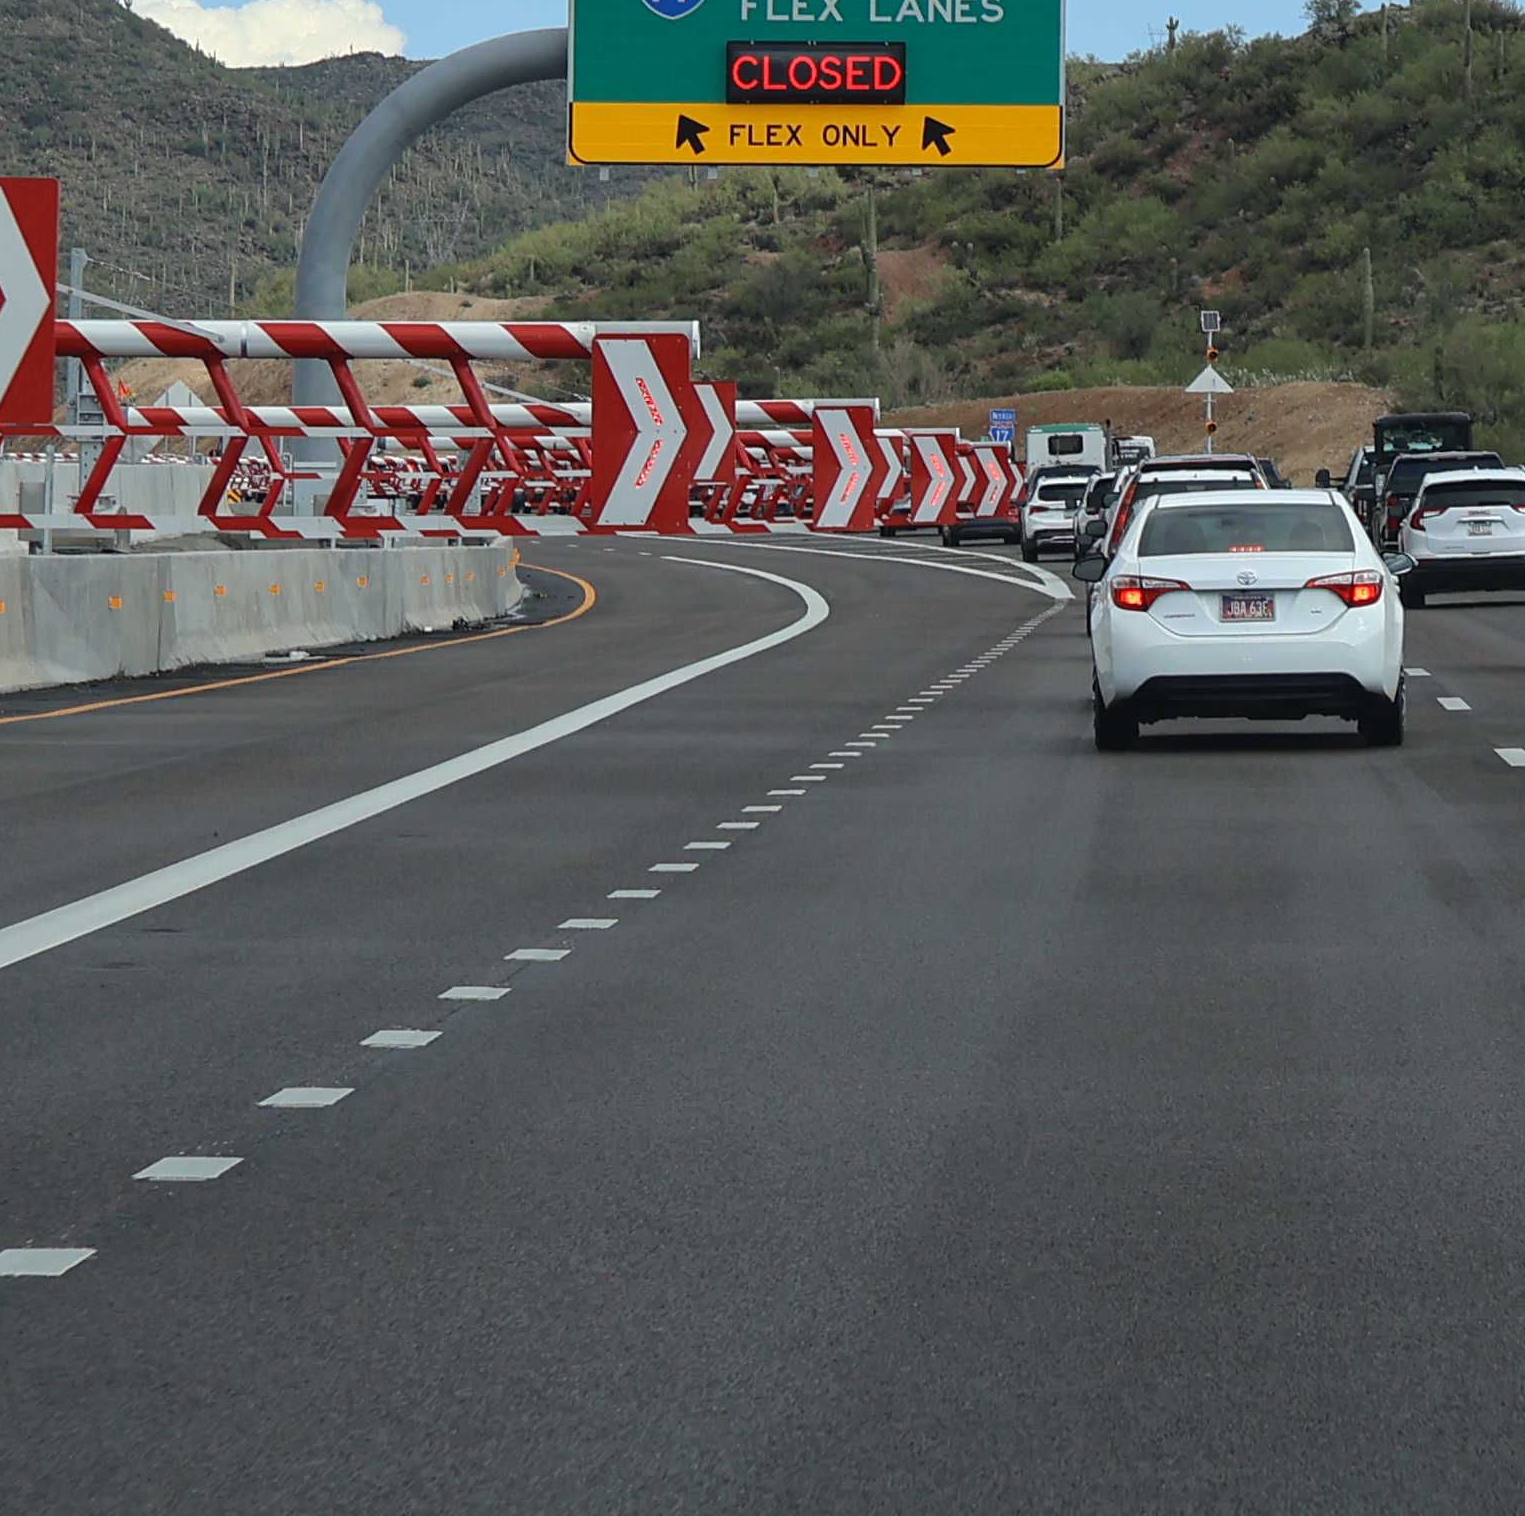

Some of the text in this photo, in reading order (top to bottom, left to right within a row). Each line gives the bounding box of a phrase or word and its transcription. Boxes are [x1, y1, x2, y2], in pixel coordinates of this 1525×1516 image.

[732, 55, 902, 90] CLOSED
[729, 124, 901, 147] FLEX ONLY
[996, 430, 1009, 443] 17
